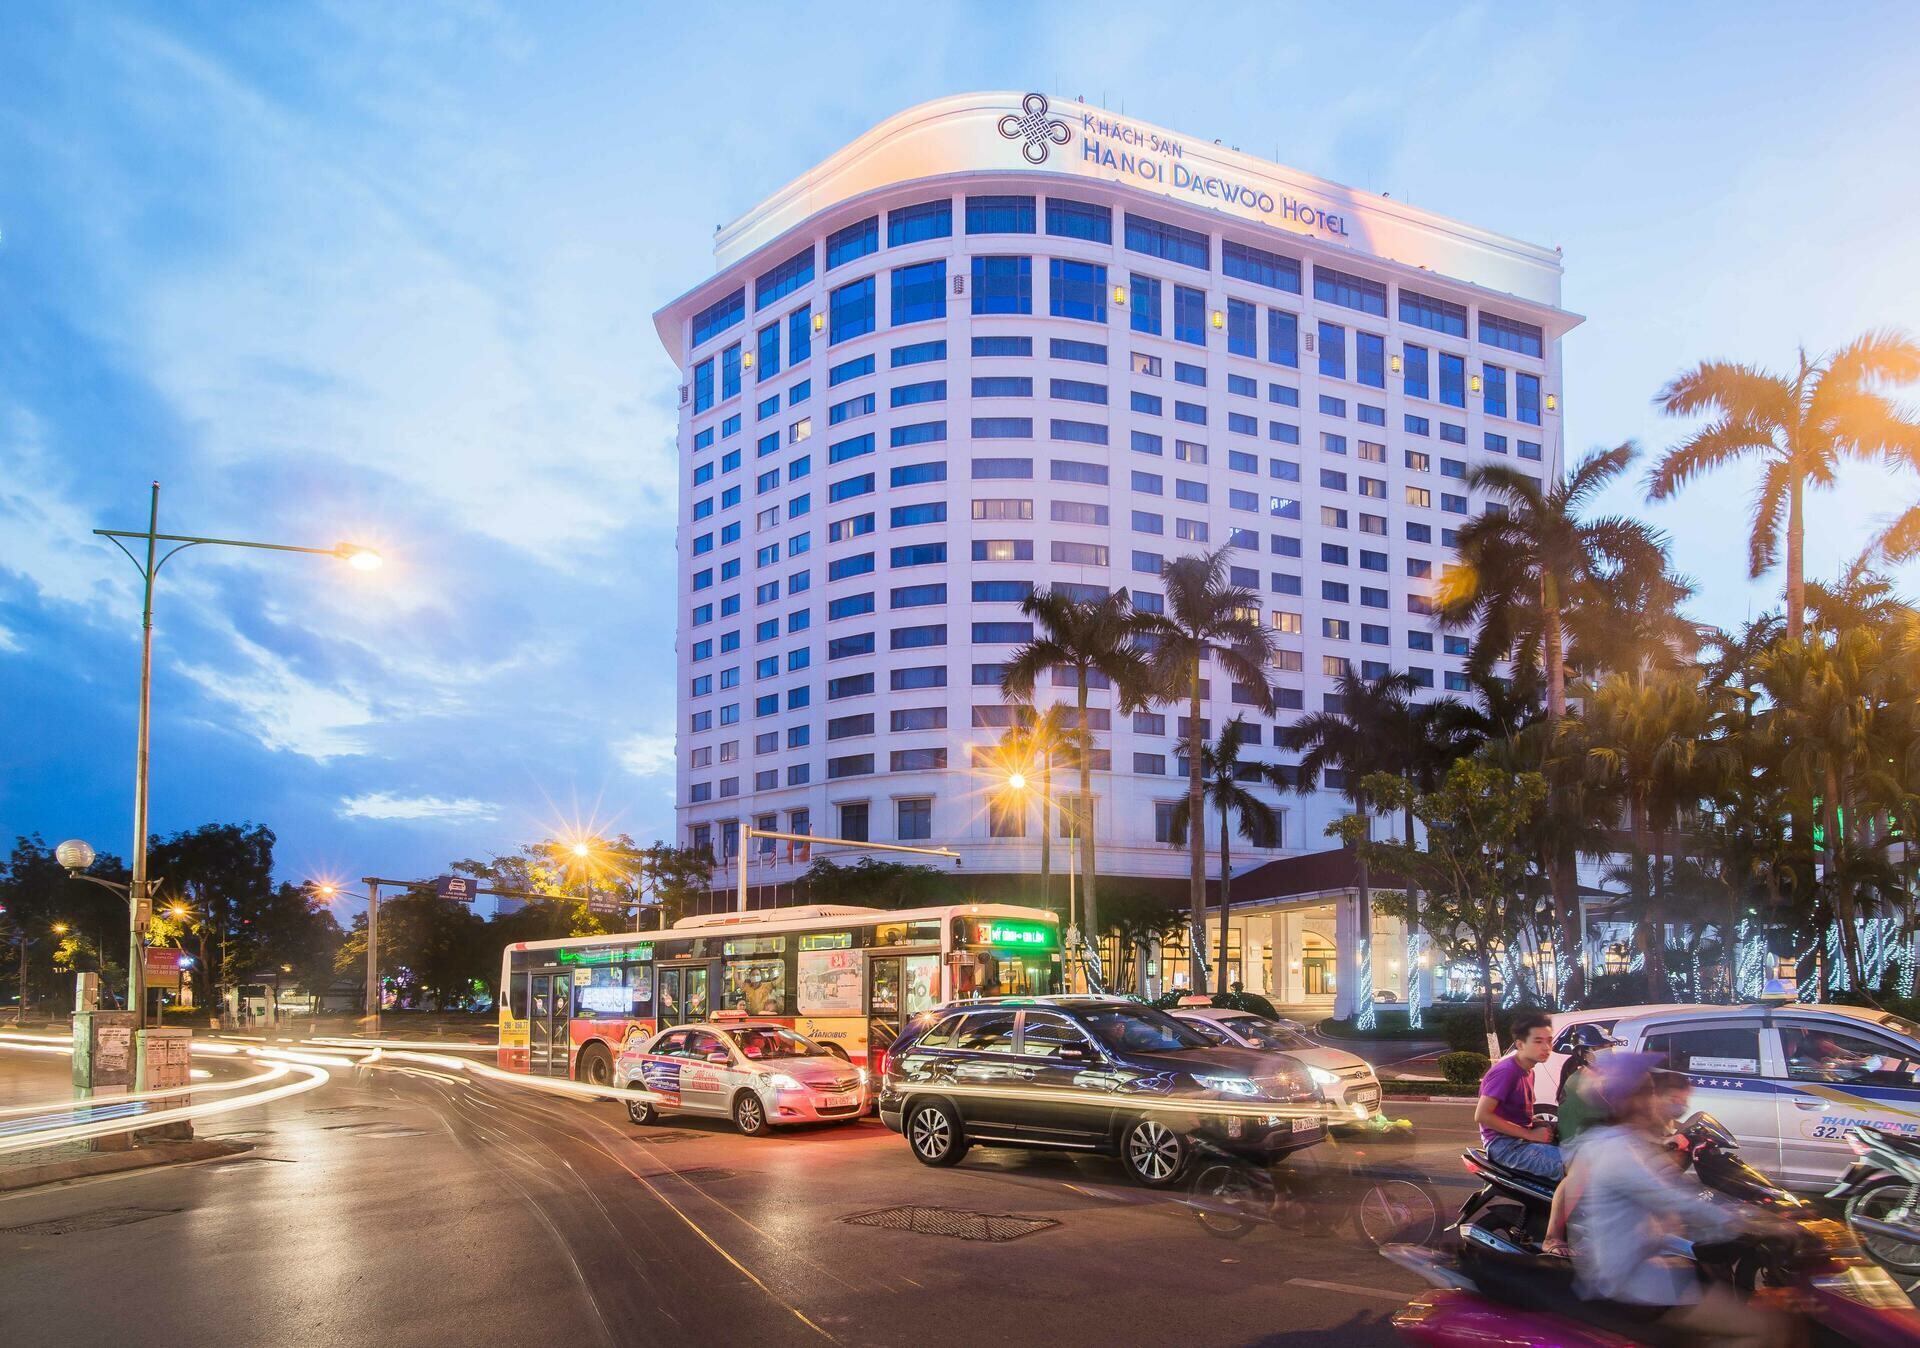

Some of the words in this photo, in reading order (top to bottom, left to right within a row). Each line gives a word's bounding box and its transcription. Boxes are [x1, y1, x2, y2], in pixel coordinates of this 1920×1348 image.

[1084, 114, 1144, 147] KHÁCH
[1150, 134, 1182, 159] SẠN
[1083, 137, 1163, 183] HANOI
[1173, 163, 1274, 213] DAEWOO
[1283, 197, 1348, 236] HOTEL
